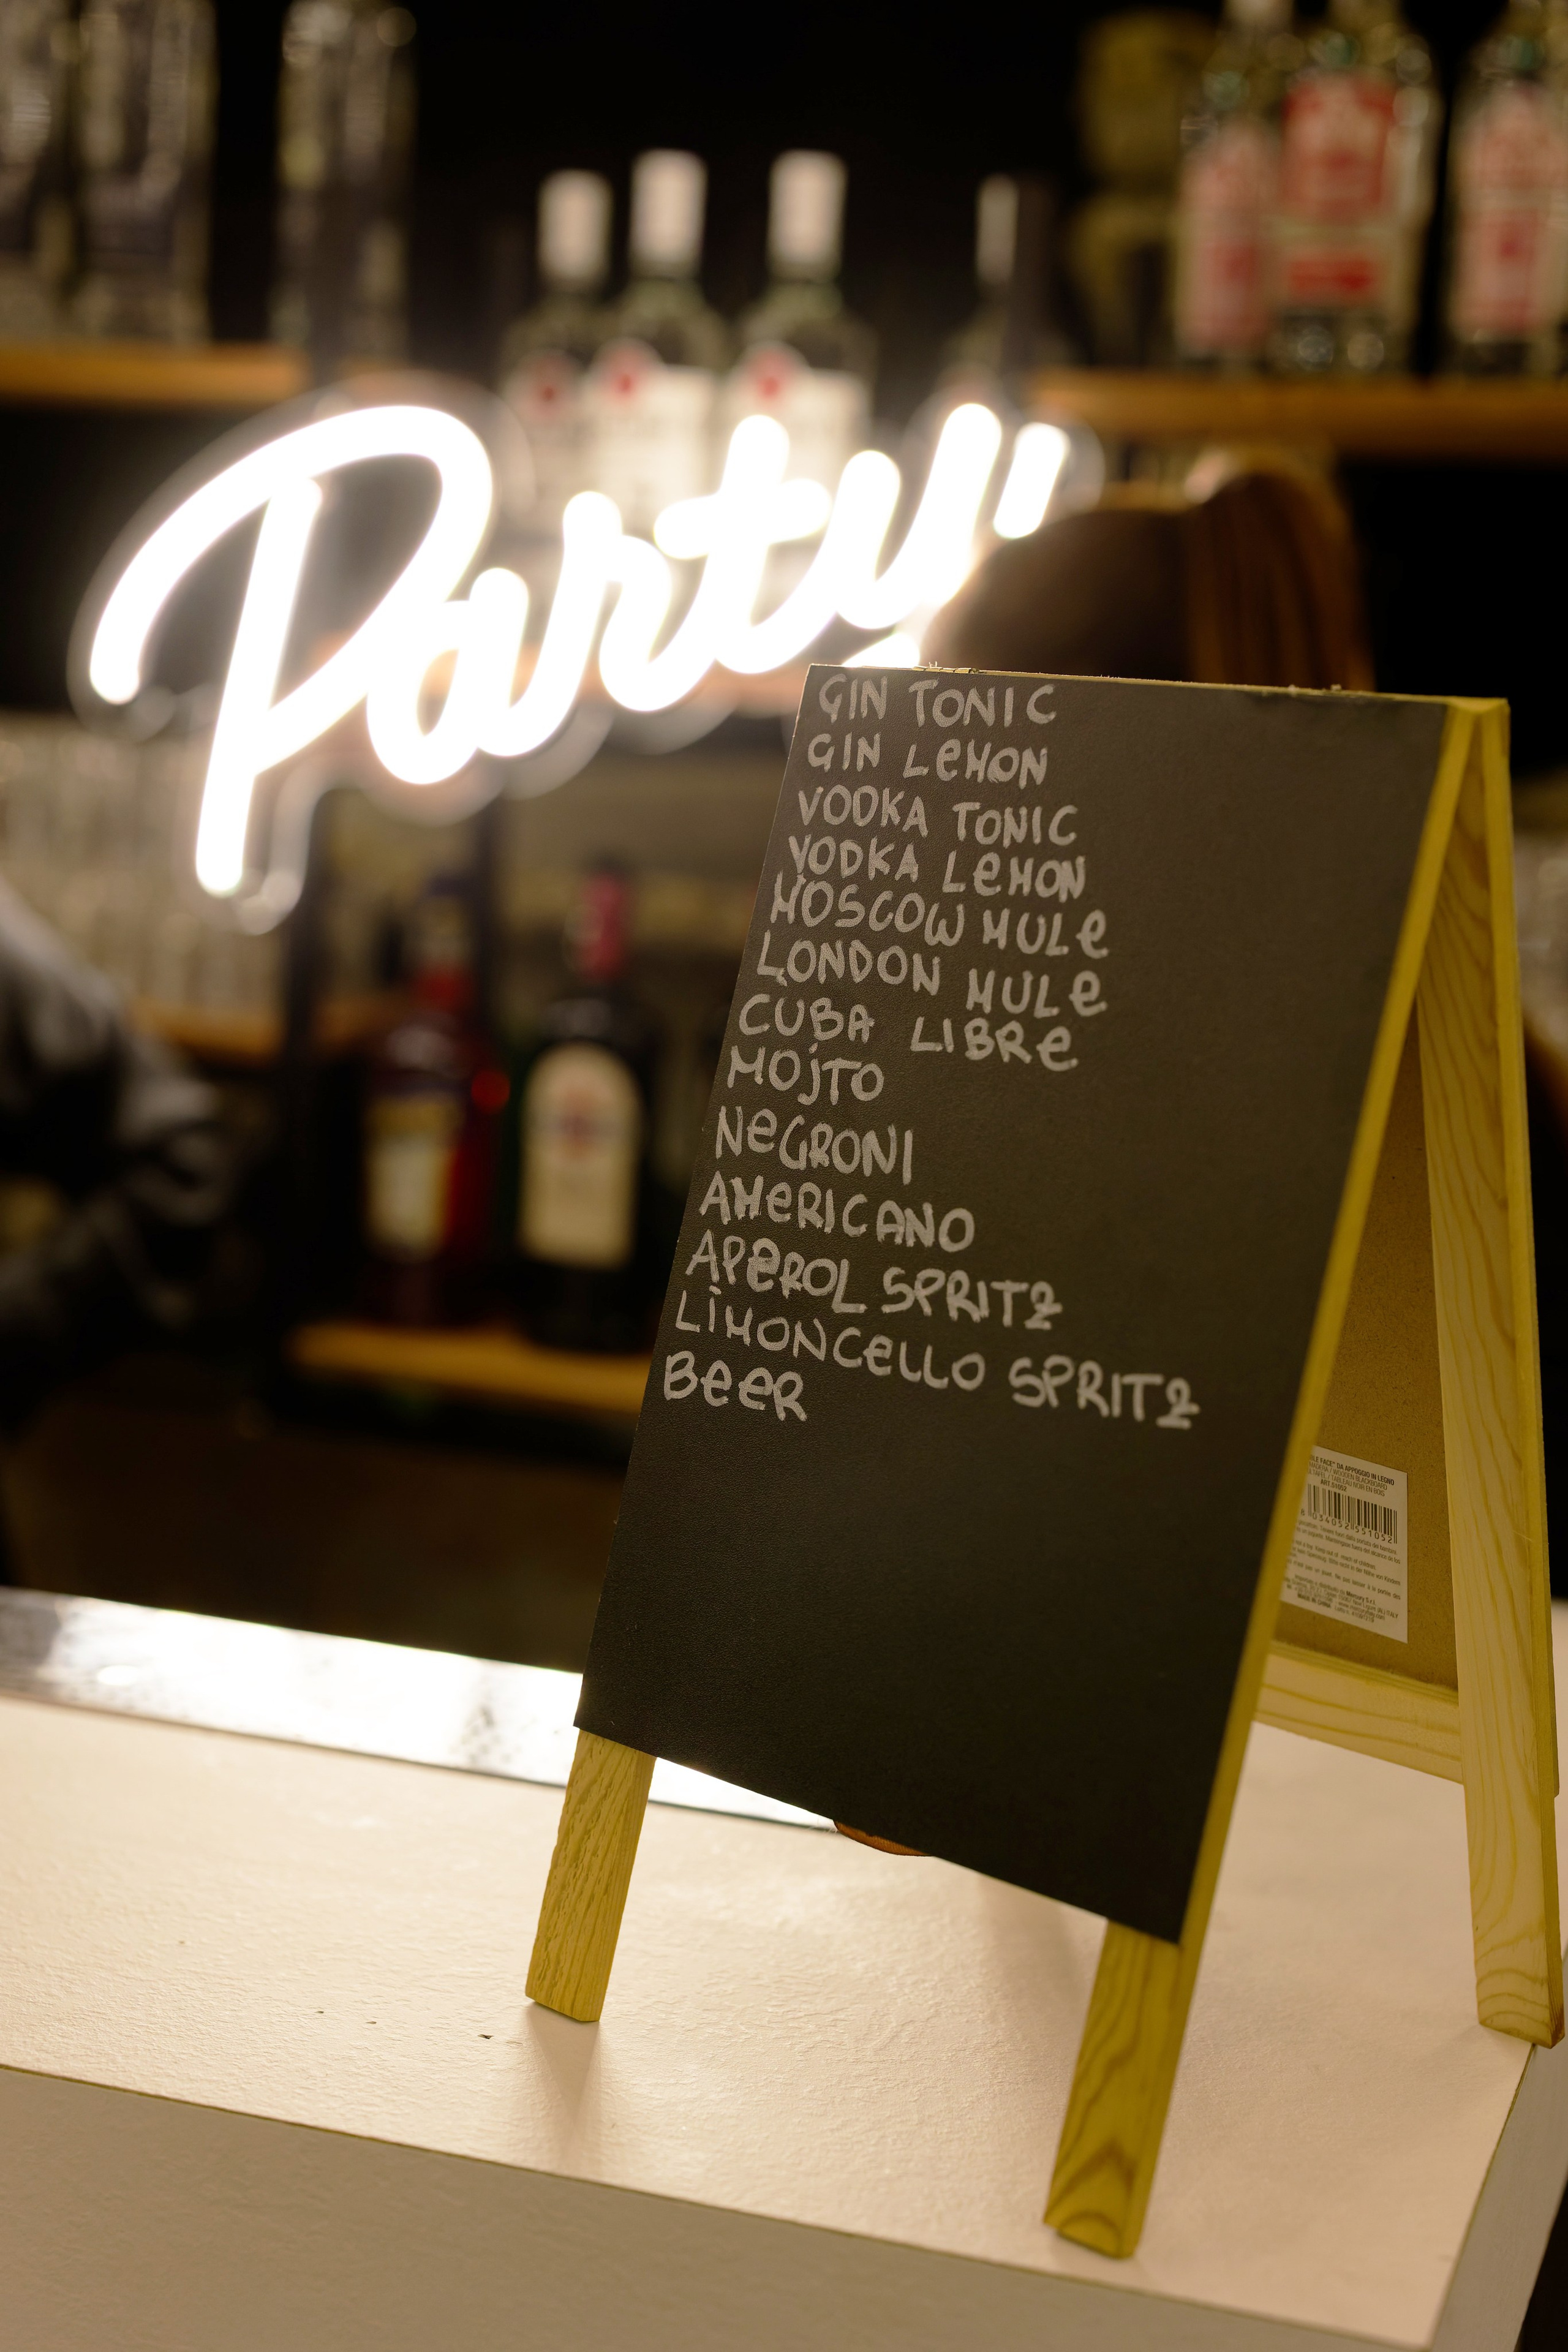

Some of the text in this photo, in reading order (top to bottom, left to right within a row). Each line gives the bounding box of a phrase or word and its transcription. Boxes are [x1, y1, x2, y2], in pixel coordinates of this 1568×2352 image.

[819, 673, 1057, 728] GIN TONIC
[807, 733, 881, 772] GIN
[797, 785, 1079, 848] VODKA TONIC
[788, 835, 919, 882] VODKA
[769, 872, 965, 948] MOSCOW
[756, 930, 941, 997] LONDON
[737, 993, 875, 1044] CUBA
[881, 1266, 1063, 1331] SPRITZ
[1008, 1354, 1200, 1430] SPRITZ
[1333, 1468, 1355, 1481] WOODEN
[1355, 1475, 1387, 1491] BLACKBOARD
[1336, 1462, 1344, 1471] DA
[1345, 1464, 1370, 1479] APPOGGIO
[1378, 1474, 1395, 1486] LEGNO
[1366, 1485, 1373, 1493] EN
[1373, 1487, 1385, 1497] BOIS
[1355, 1525, 1393, 1544] 551052
